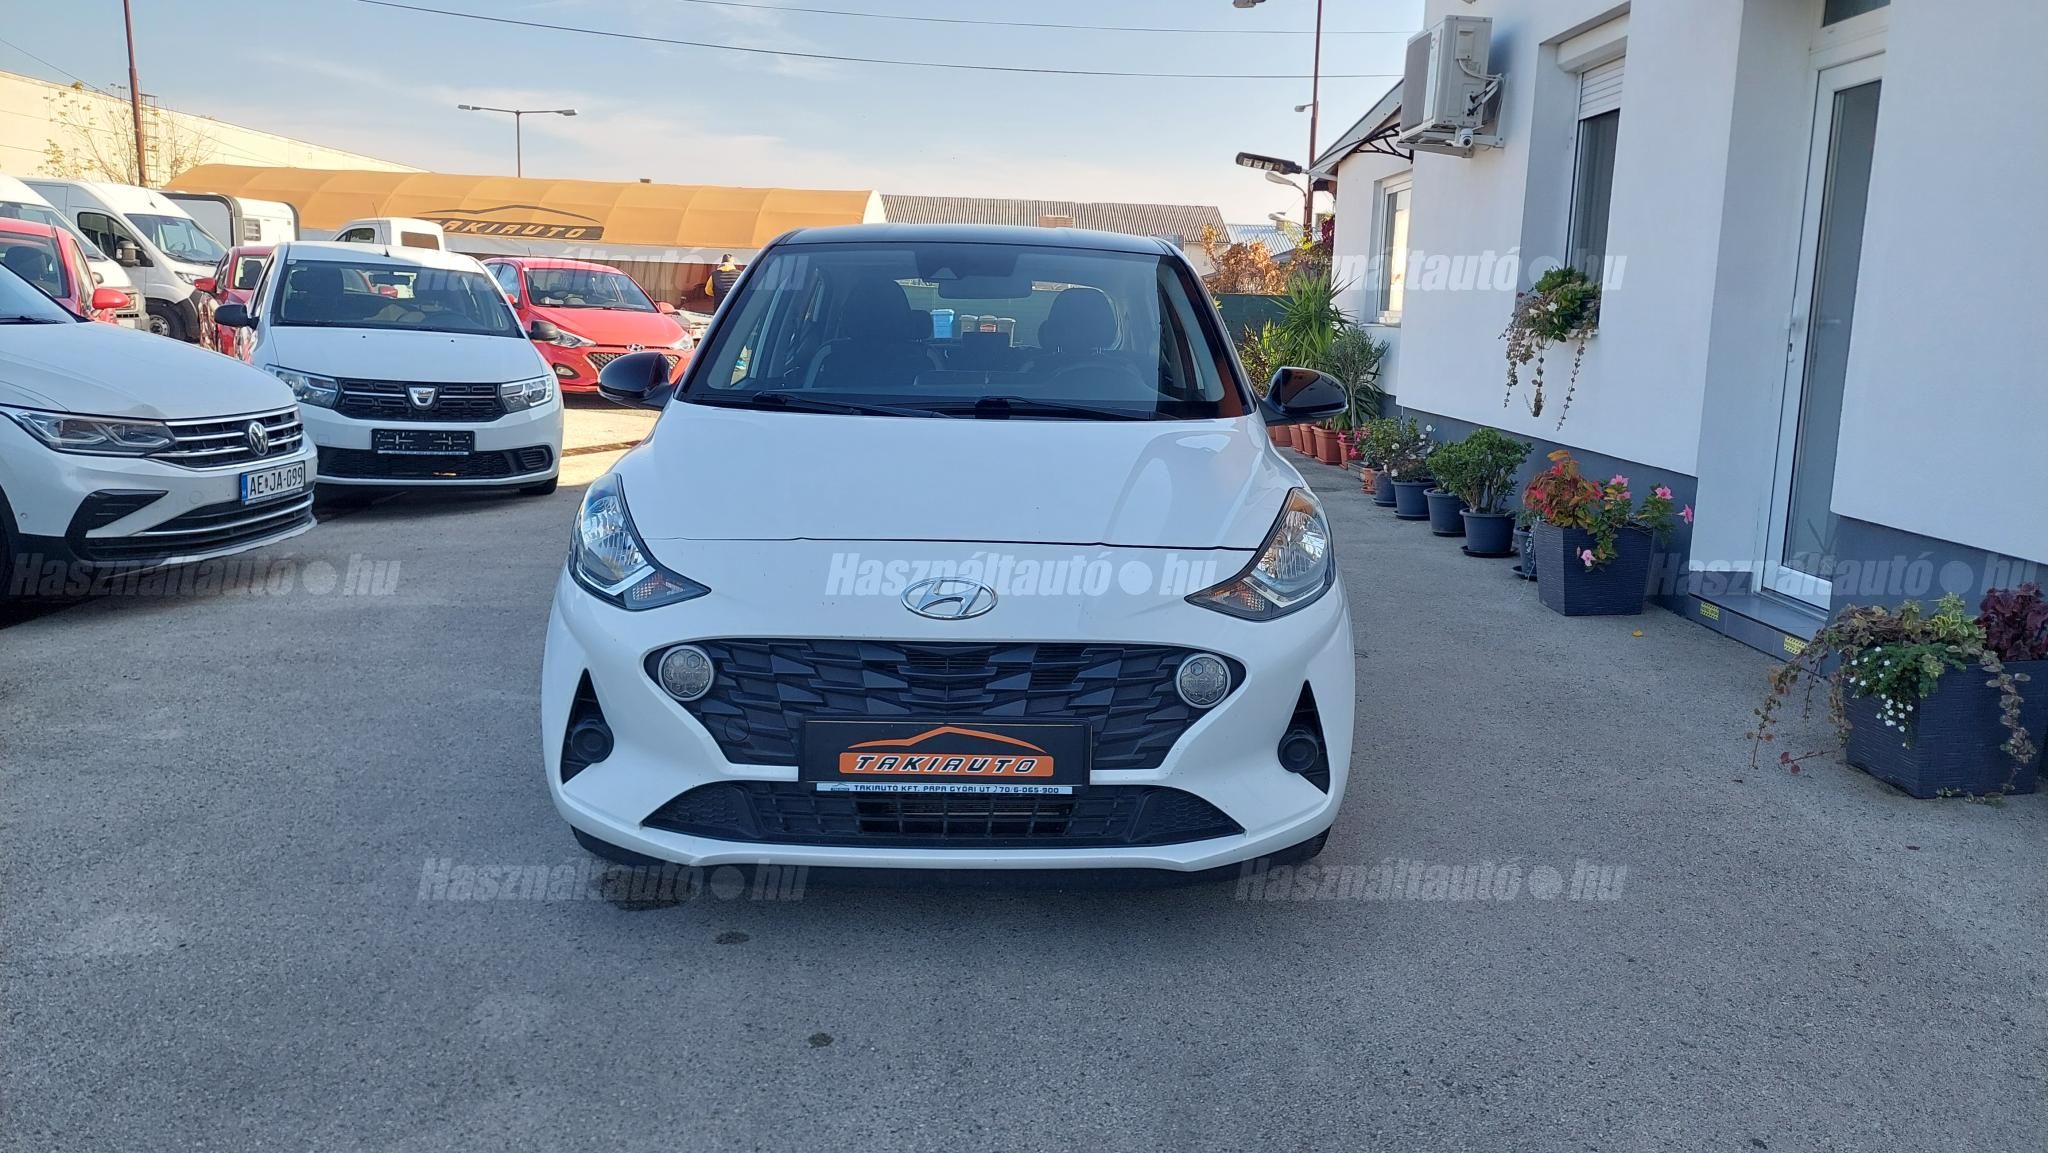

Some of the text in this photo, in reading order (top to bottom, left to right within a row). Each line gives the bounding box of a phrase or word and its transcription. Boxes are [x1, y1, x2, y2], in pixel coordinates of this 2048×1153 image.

[432, 219, 587, 238] AKIAUTO
[249, 466, 303, 496] AE JA-099
[854, 755, 1038, 774] TAKIAUTO
[854, 784, 899, 792] TAKIAUTO
